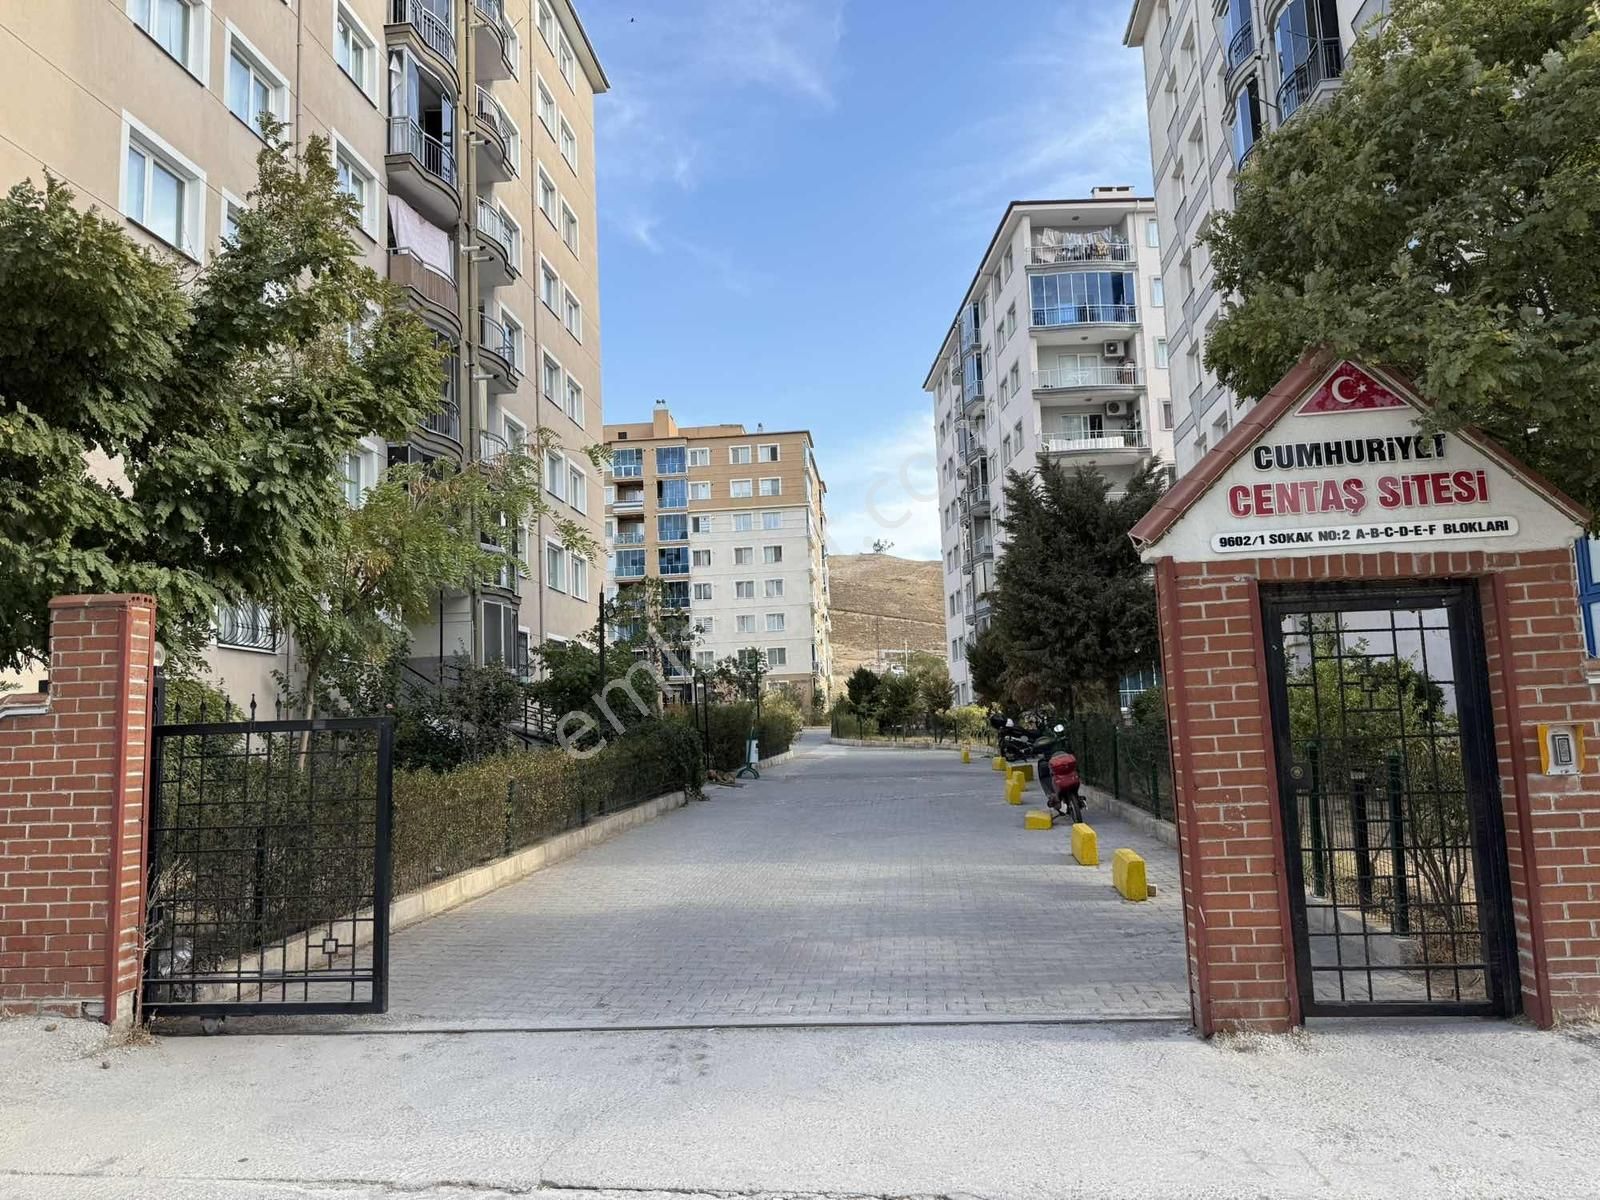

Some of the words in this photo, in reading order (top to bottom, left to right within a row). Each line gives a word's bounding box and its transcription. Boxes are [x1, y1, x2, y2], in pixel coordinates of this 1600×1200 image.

[1228, 478, 1367, 517] CENTAŞ
[1219, 535, 1265, 547] 9602/1
[1269, 531, 1313, 544] SOKAK
[1318, 529, 1350, 541] NO:2
[1356, 524, 1436, 539] A-B-C-D-E-F
[1443, 519, 1509, 534] BLOKLARI
